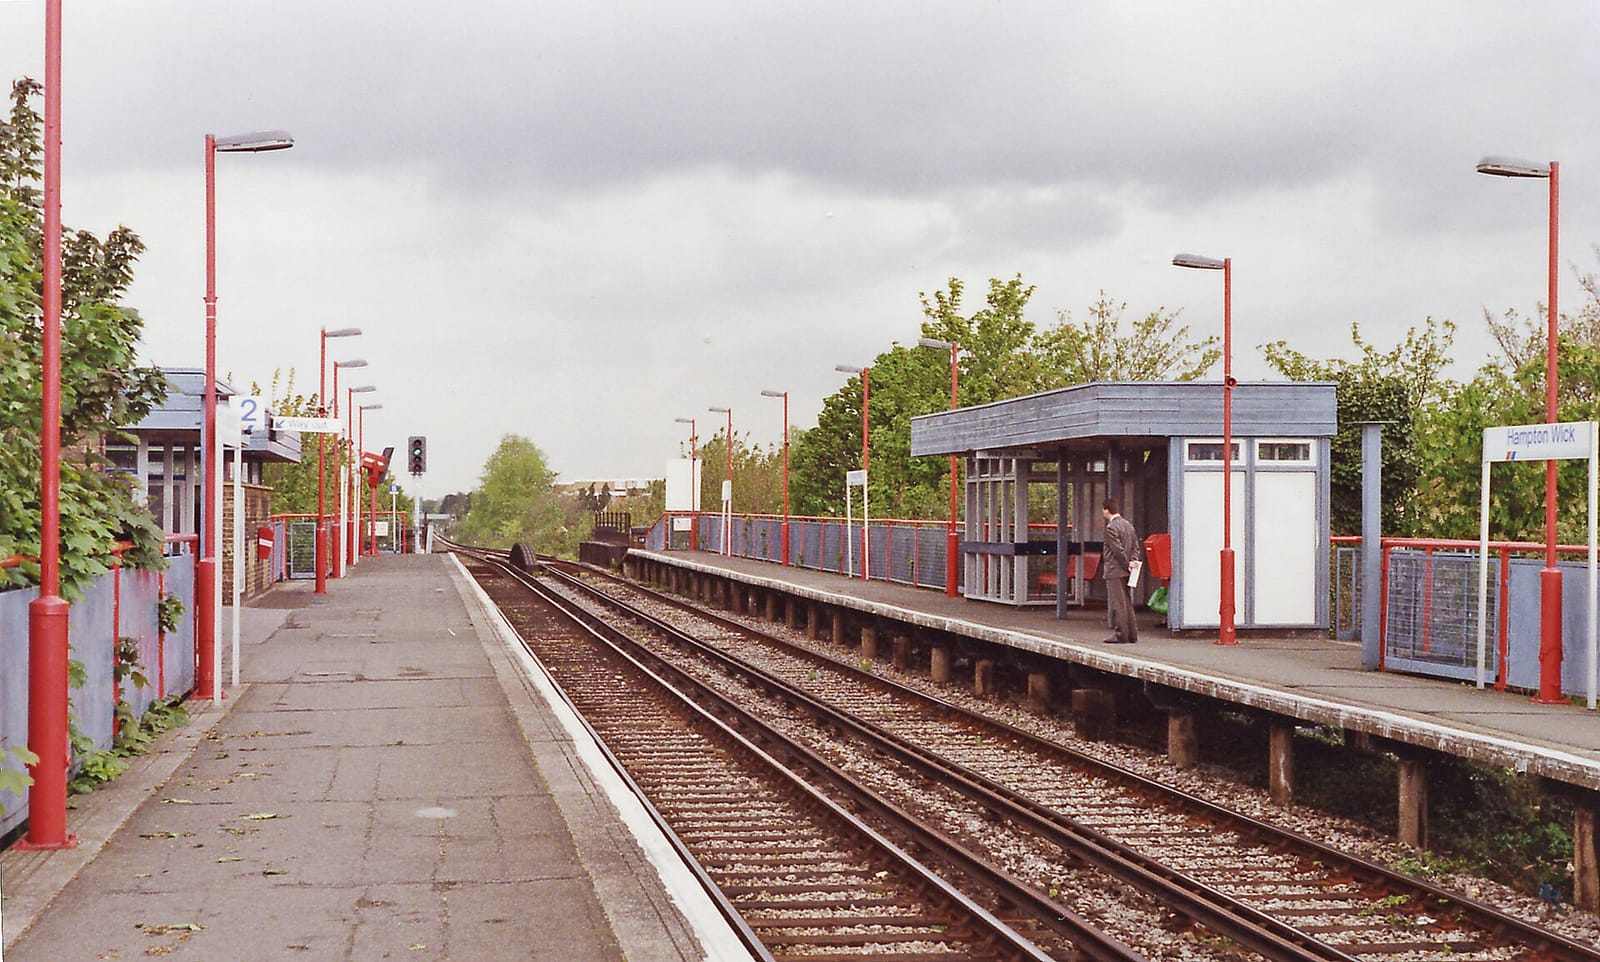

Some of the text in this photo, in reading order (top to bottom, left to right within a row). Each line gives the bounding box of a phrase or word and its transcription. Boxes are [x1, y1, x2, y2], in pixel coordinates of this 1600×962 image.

[240, 399, 257, 421] 2
[1507, 425, 1575, 448] Hampton Wick
